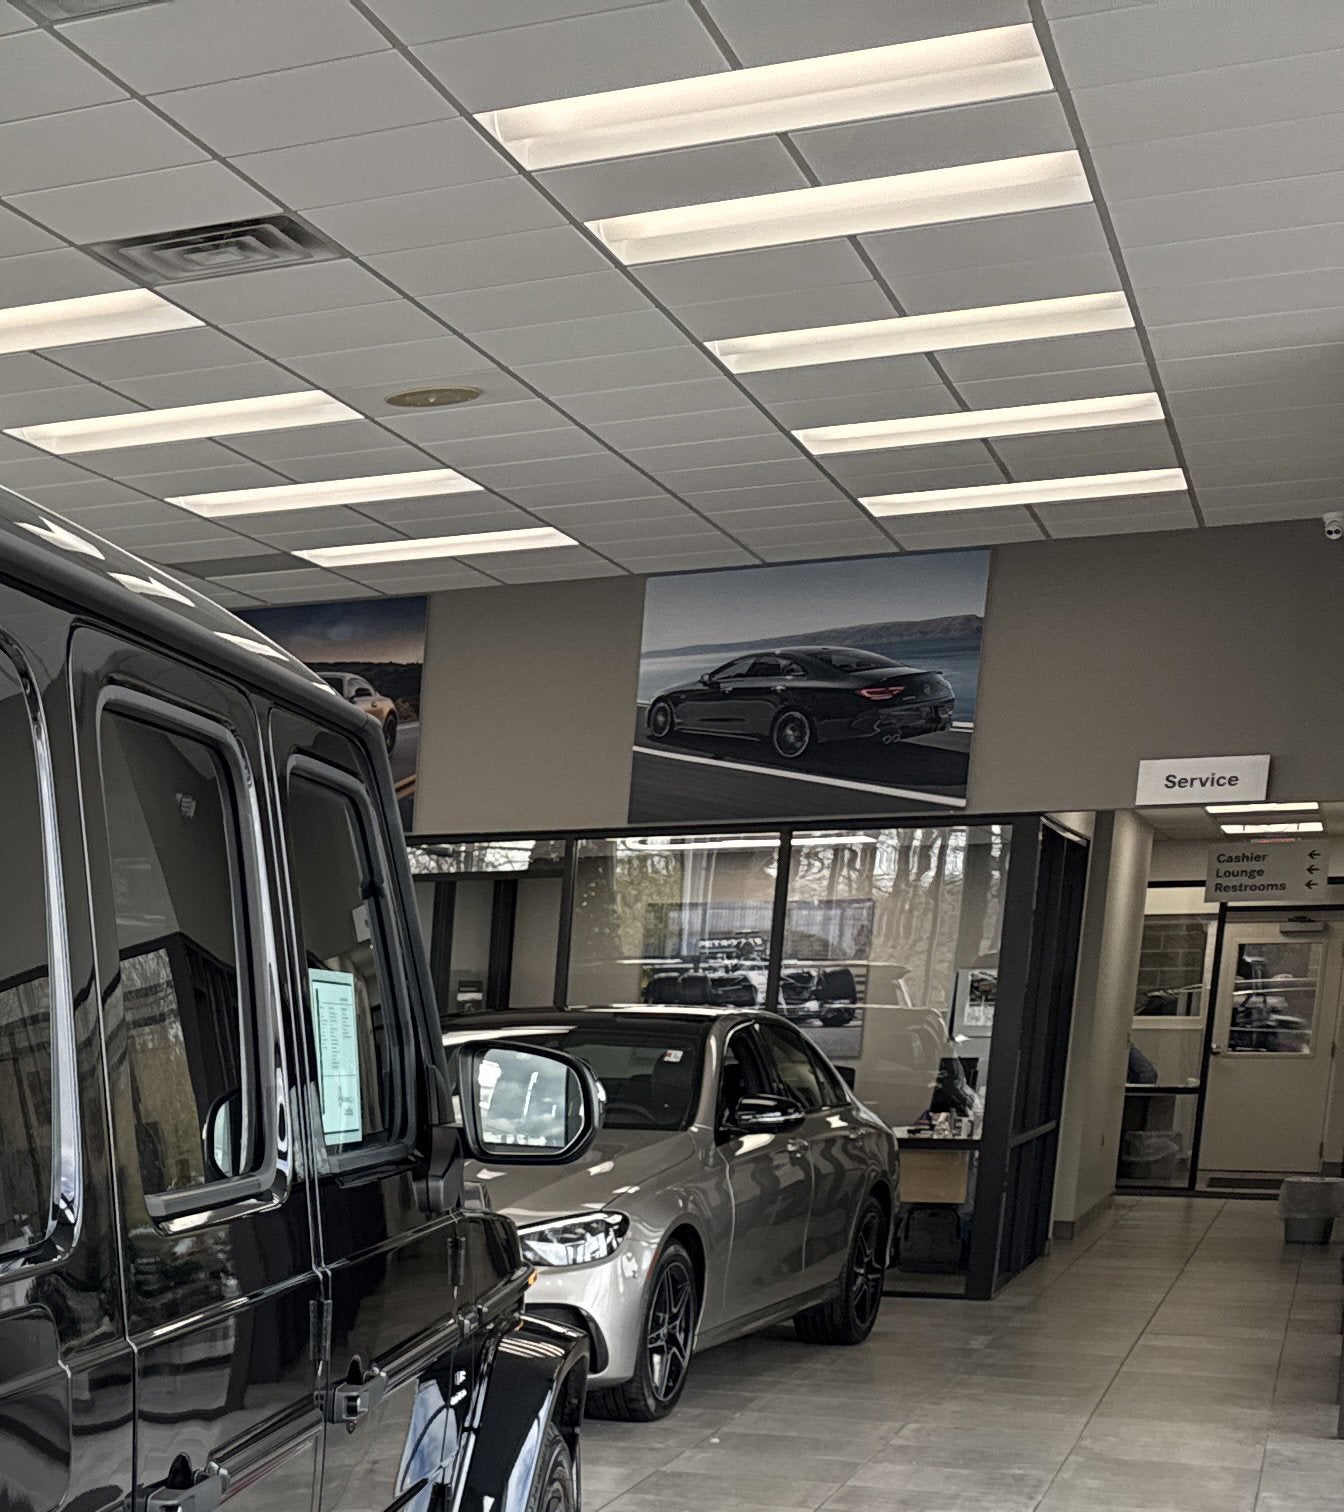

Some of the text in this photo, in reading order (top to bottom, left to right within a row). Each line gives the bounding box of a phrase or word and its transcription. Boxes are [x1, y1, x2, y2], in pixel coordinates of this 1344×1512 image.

[1164, 772, 1239, 789] Service
[1216, 852, 1268, 864] Cashier
[1215, 867, 1265, 880] Lounge
[1214, 881, 1287, 893] Restrooms
